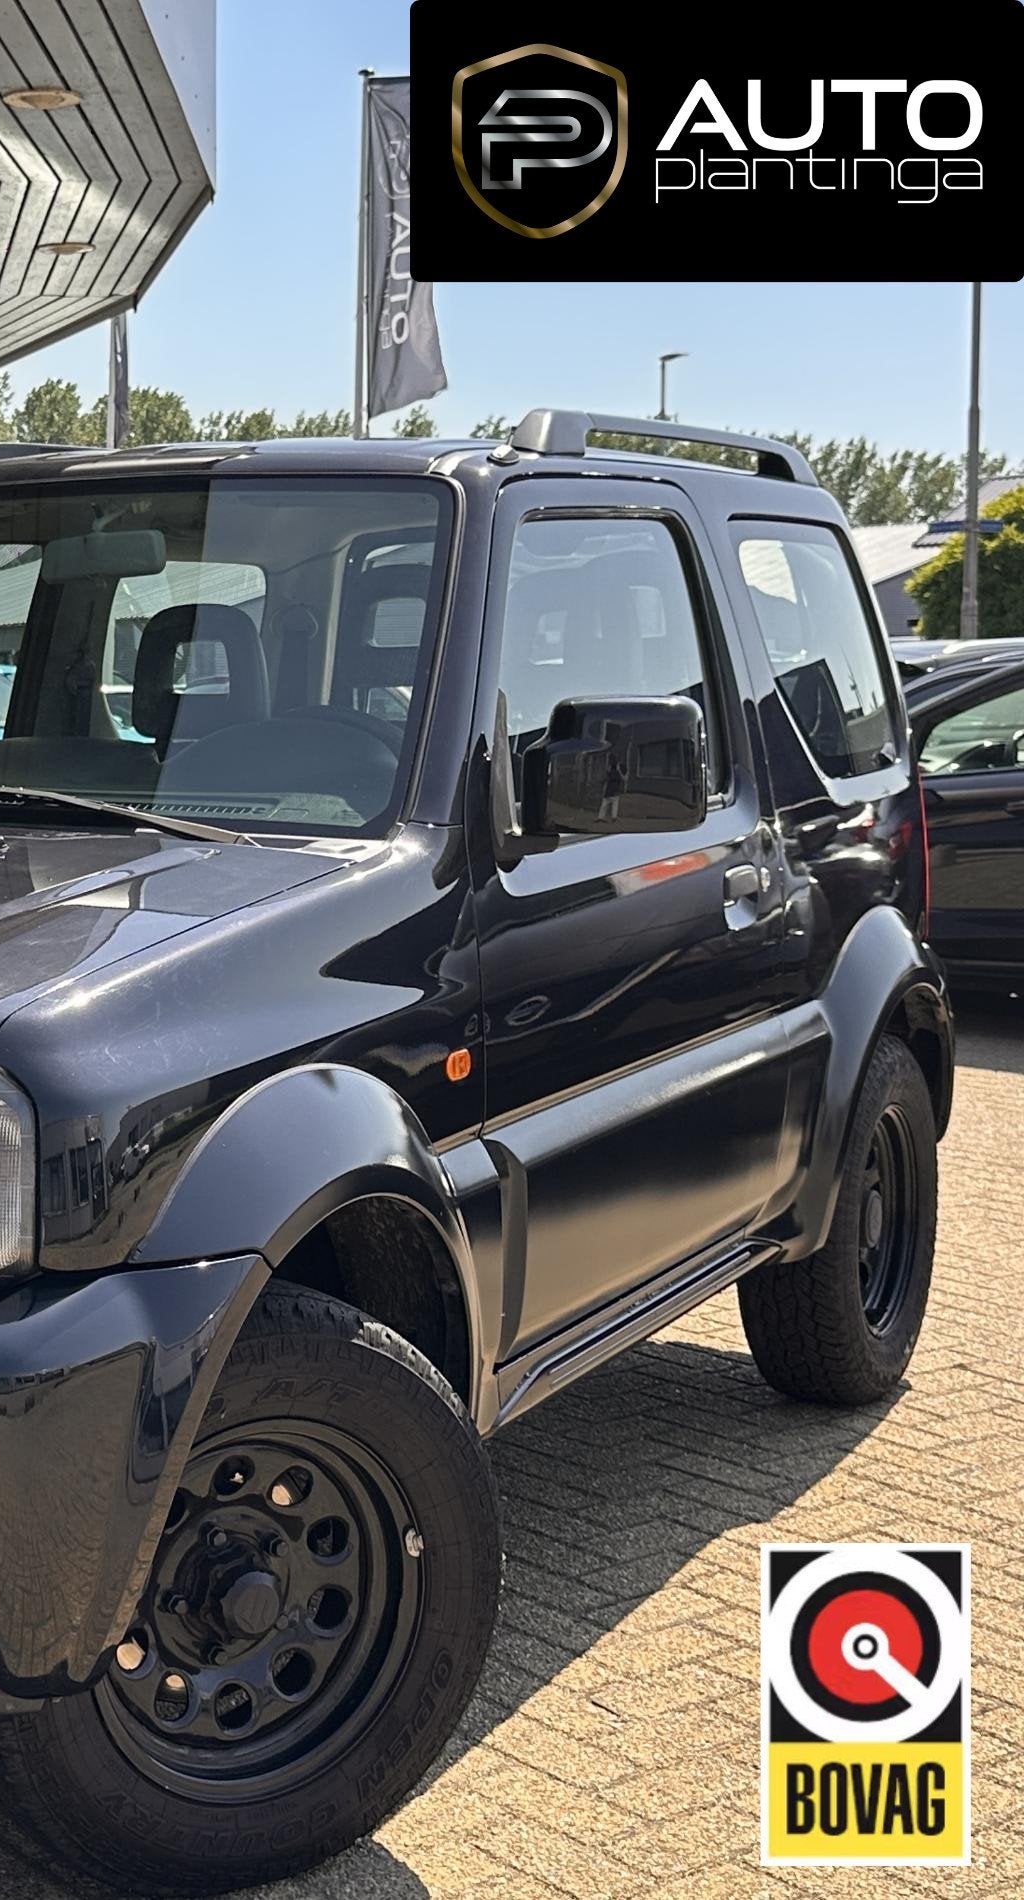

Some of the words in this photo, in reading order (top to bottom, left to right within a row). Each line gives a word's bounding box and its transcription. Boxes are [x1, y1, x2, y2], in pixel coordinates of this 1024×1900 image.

[390, 212, 412, 344] AUTO
[355, 1647, 455, 1803] OPEN
[95, 1790, 338, 1850] COUNRY
